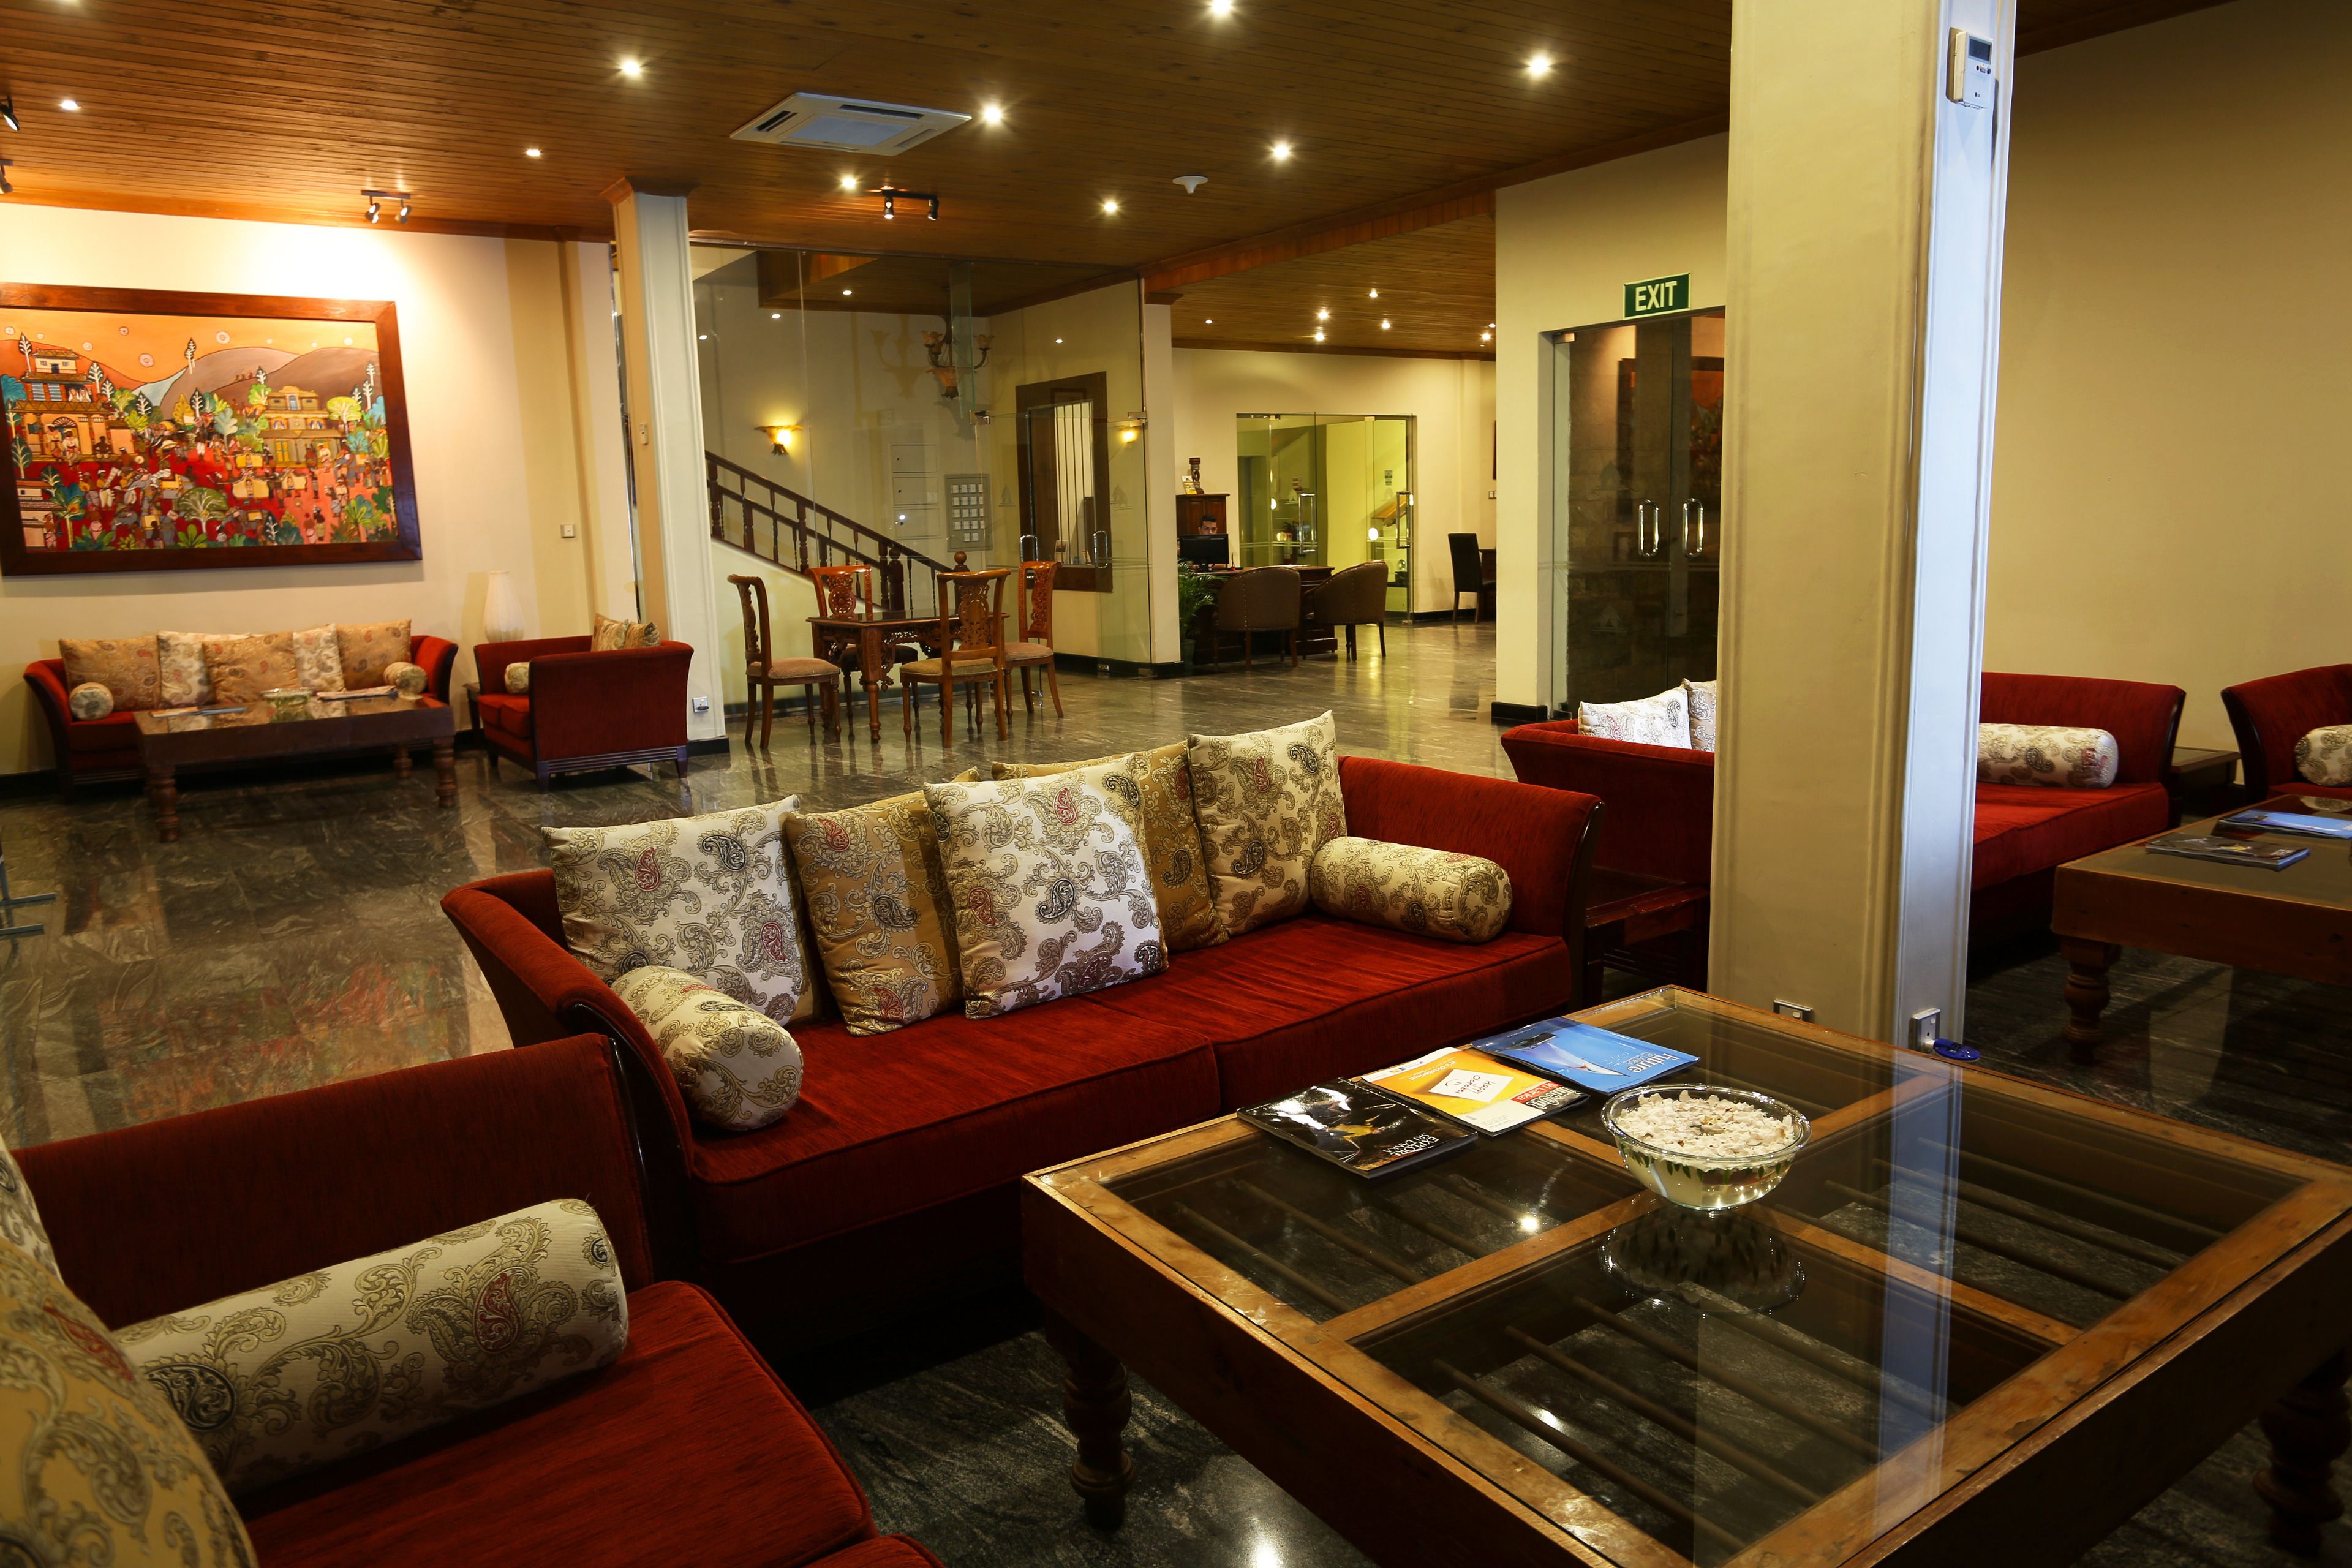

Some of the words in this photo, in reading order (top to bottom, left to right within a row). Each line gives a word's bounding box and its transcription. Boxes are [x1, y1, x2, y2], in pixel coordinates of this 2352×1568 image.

[1635, 281, 1678, 312] EXIT
[1627, 1053, 1680, 1073] Future
[1516, 1087, 1547, 1101] Lanka
[1542, 1082, 1559, 1090] Sri
[1382, 1139, 1415, 1153] LANKA
[1390, 1136, 1439, 1157] EXPLORE
